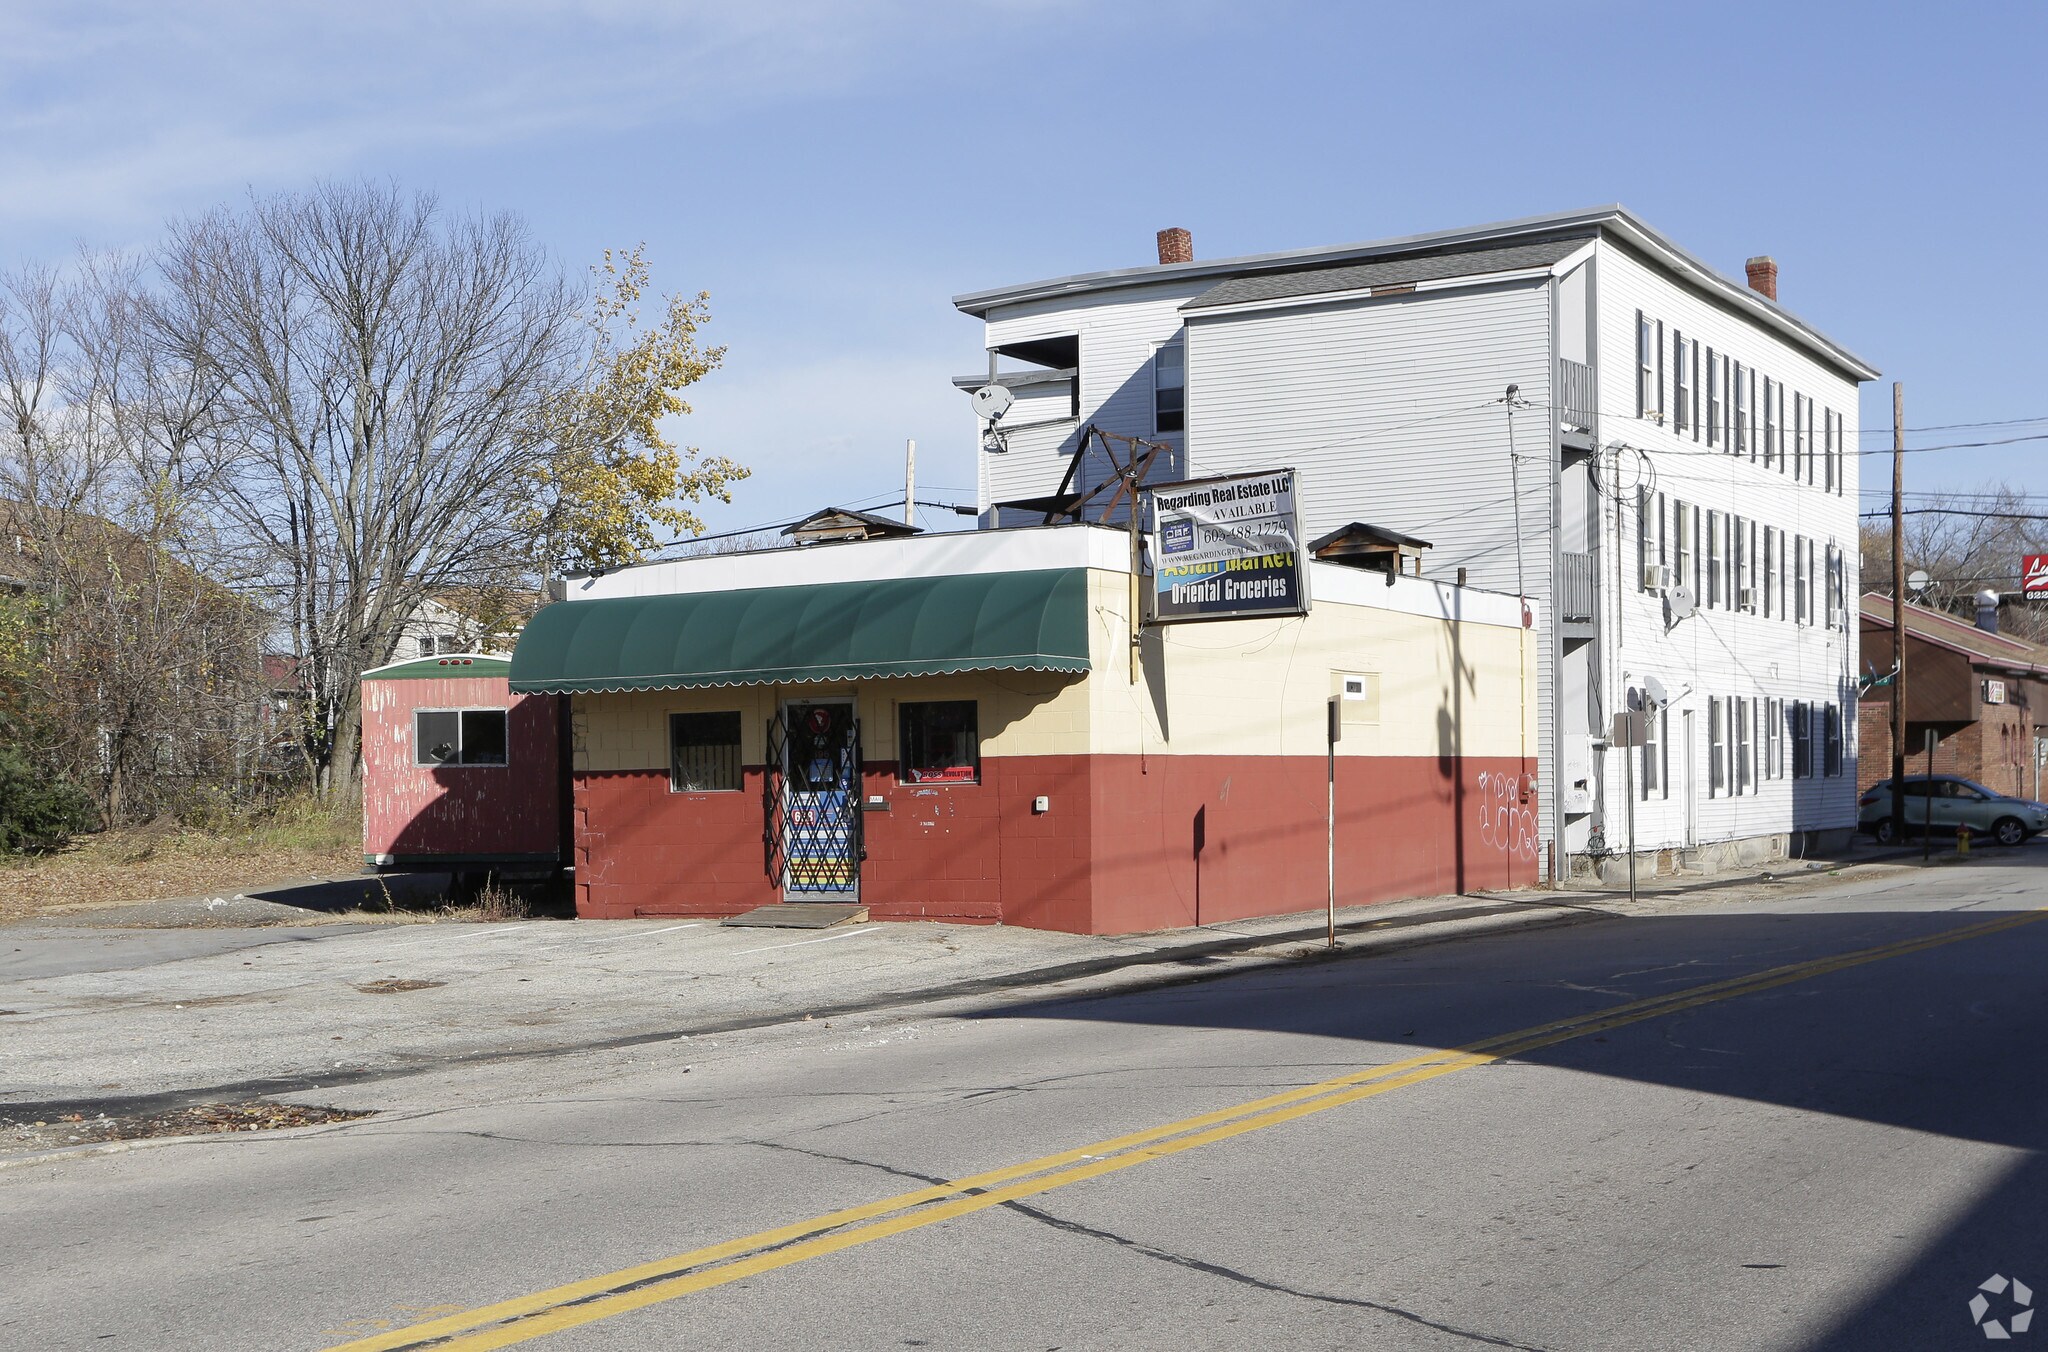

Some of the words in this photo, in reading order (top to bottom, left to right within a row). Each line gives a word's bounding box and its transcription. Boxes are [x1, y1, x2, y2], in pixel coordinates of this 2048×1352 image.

[1157, 491, 1211, 511] Regarding
[1211, 486, 1236, 504] Real
[1238, 481, 1271, 500] Estate
[1272, 477, 1290, 494] LLC
[1212, 501, 1278, 521] AVAILABLE
[1204, 520, 1288, 544] 603-488-1779
[1171, 579, 1221, 605] Oriental
[1225, 575, 1287, 601] Groceries
[922, 770, 943, 779] BOSS
